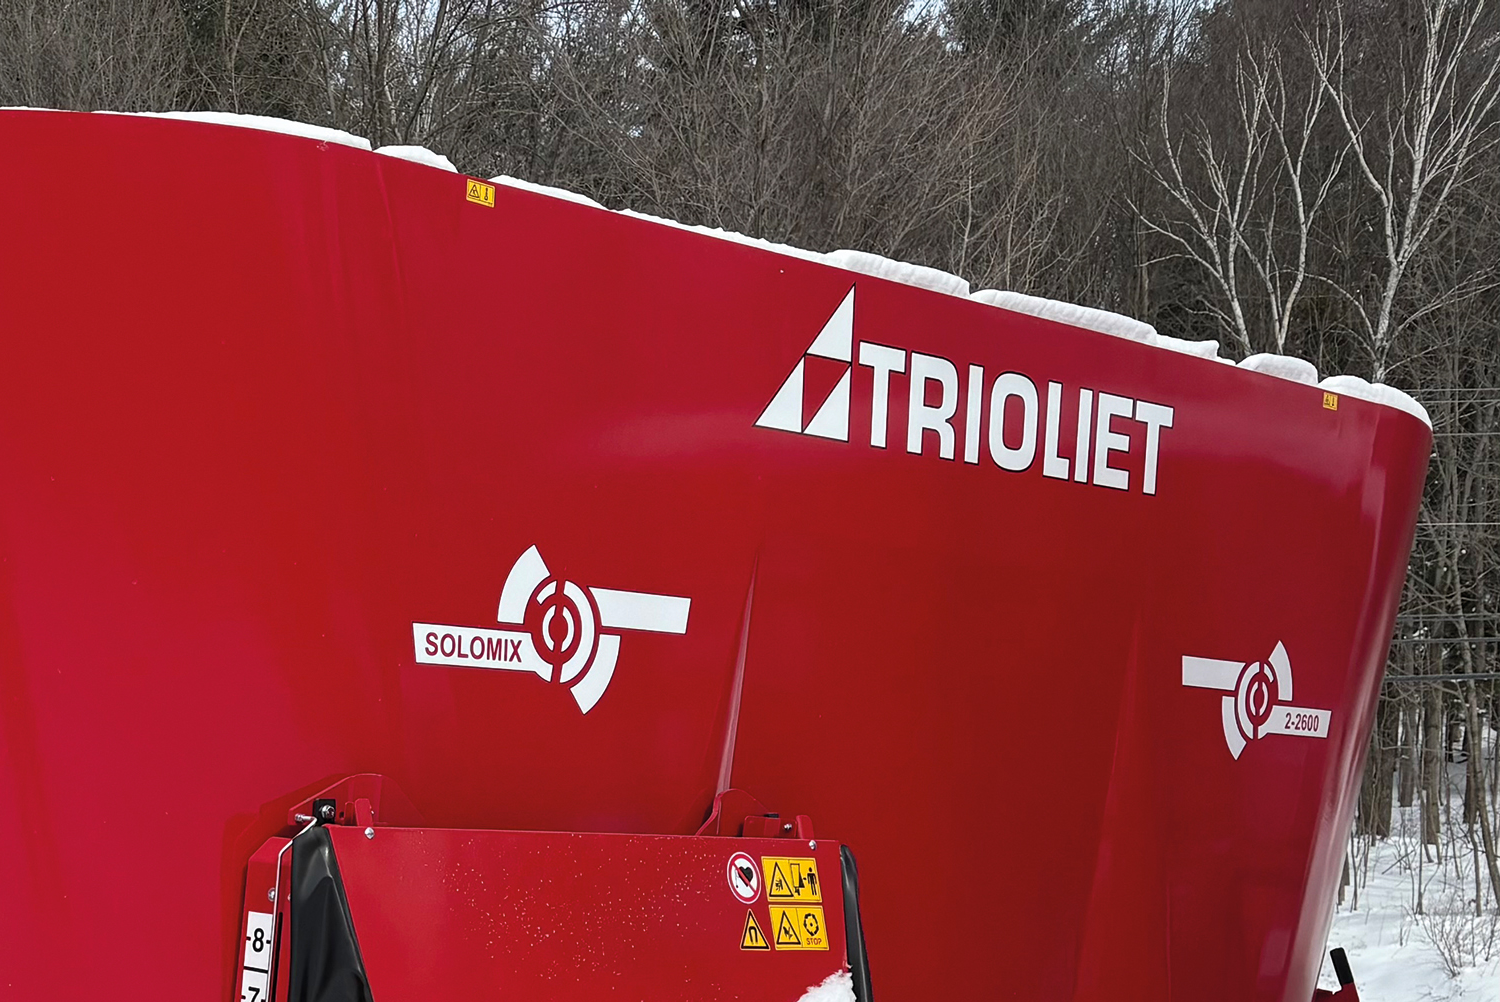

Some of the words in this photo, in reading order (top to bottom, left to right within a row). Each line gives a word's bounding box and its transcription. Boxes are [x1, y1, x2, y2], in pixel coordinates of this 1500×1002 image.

[858, 340, 1175, 496] TRIOLIET
[424, 631, 523, 663] SOLOMIX
[1284, 712, 1320, 732] 2-2600
[252, 928, 264, 953] 8
[806, 937, 822, 946] STOP
